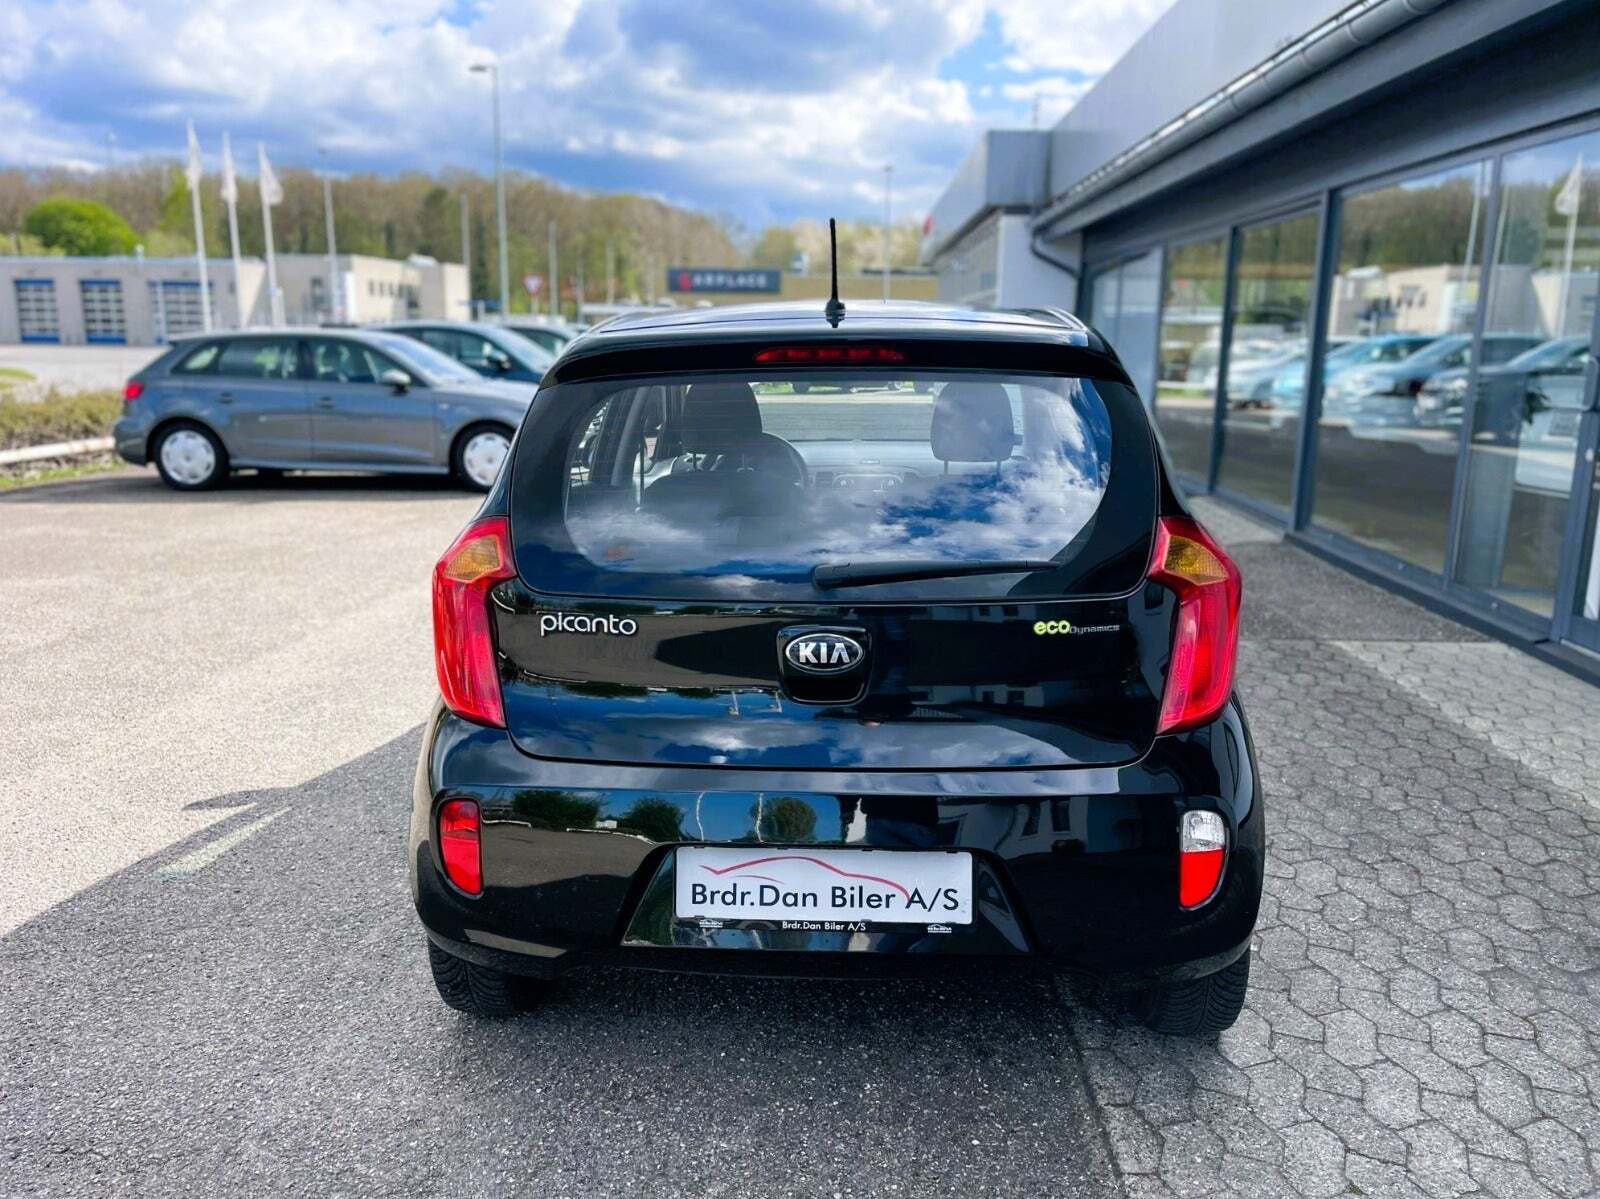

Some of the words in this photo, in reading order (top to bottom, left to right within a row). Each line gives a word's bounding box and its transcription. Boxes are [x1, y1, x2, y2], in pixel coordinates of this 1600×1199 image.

[540, 611, 637, 637] picanto
[799, 641, 851, 664] KIA
[831, 885, 896, 909] Biler
[904, 887, 959, 912] A/S
[824, 921, 845, 931] Biler
[847, 922, 867, 932] A/S
